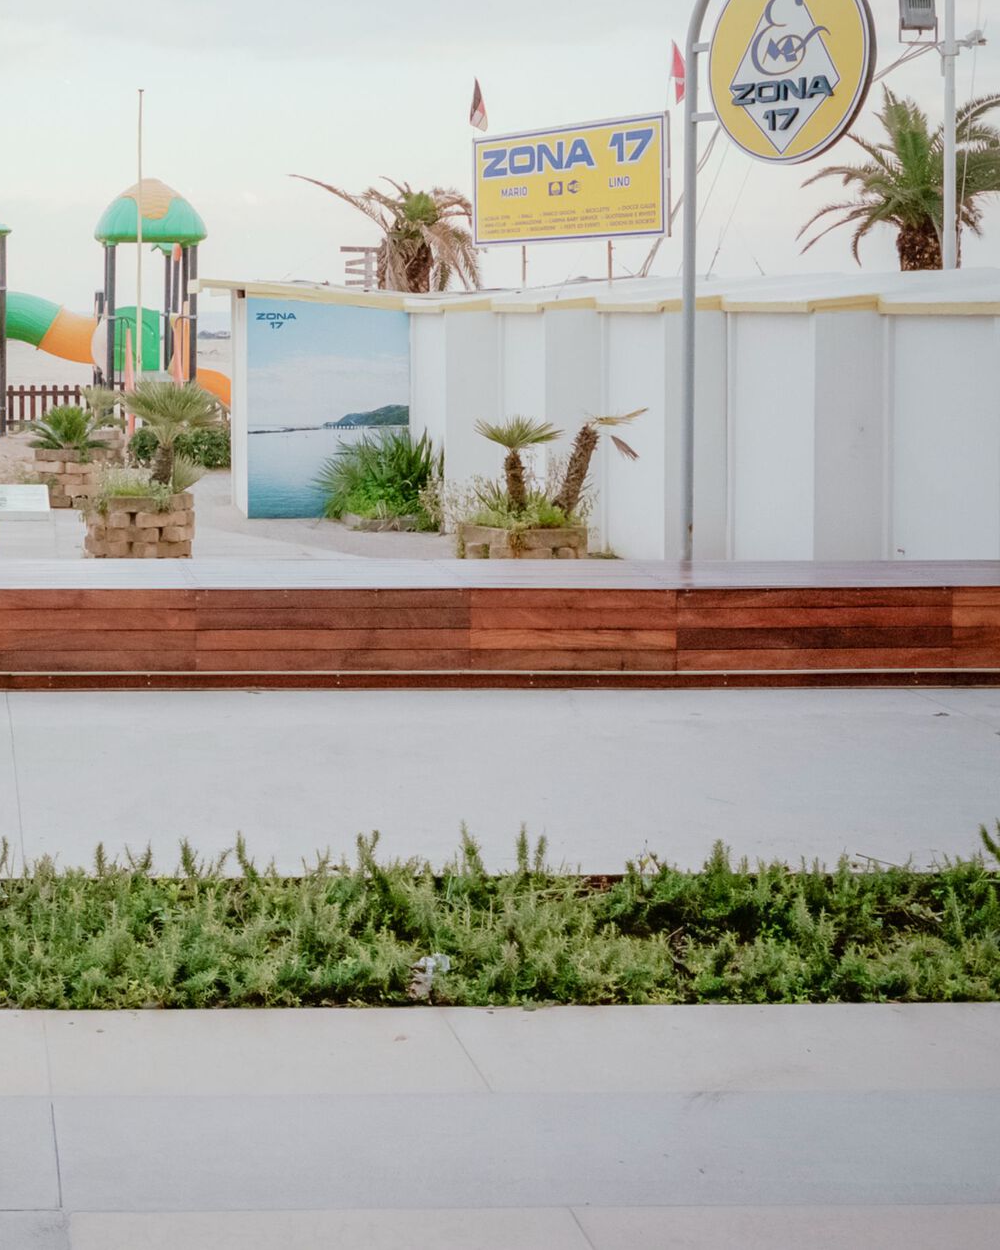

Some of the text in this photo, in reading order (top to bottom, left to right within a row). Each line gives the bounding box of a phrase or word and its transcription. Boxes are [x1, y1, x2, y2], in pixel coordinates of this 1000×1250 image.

[731, 75, 834, 106] ZONA
[763, 107, 799, 131] 17
[483, 128, 653, 178] ZONA 17
[609, 175, 631, 188] LINO
[501, 186, 528, 198] MARIO
[255, 312, 297, 320] ZONA
[270, 321, 284, 329] 17
